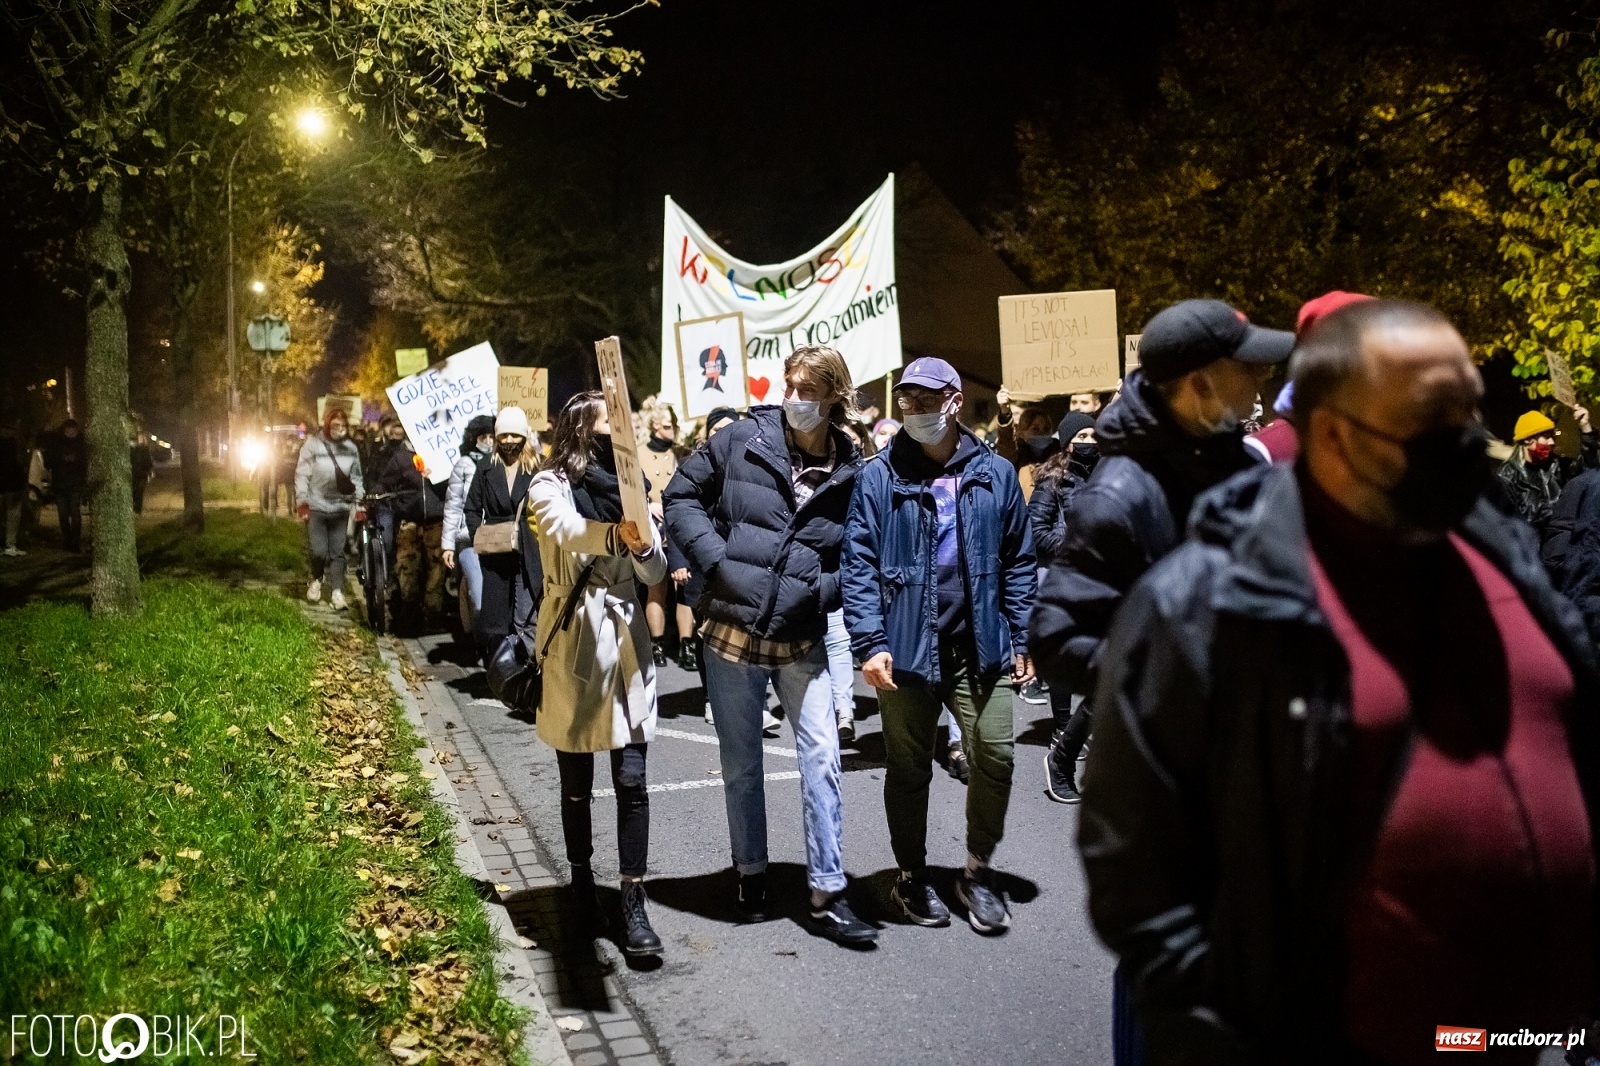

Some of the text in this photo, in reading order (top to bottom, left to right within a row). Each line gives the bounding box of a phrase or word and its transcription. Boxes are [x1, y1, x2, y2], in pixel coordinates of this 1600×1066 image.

[1044, 297, 1068, 315] NOT
[1050, 340, 1077, 361] IT'S
[397, 370, 442, 406] GDZIE
[426, 375, 481, 409] DIABEŁ
[415, 414, 441, 436] NIE
[425, 426, 461, 451] TAM
